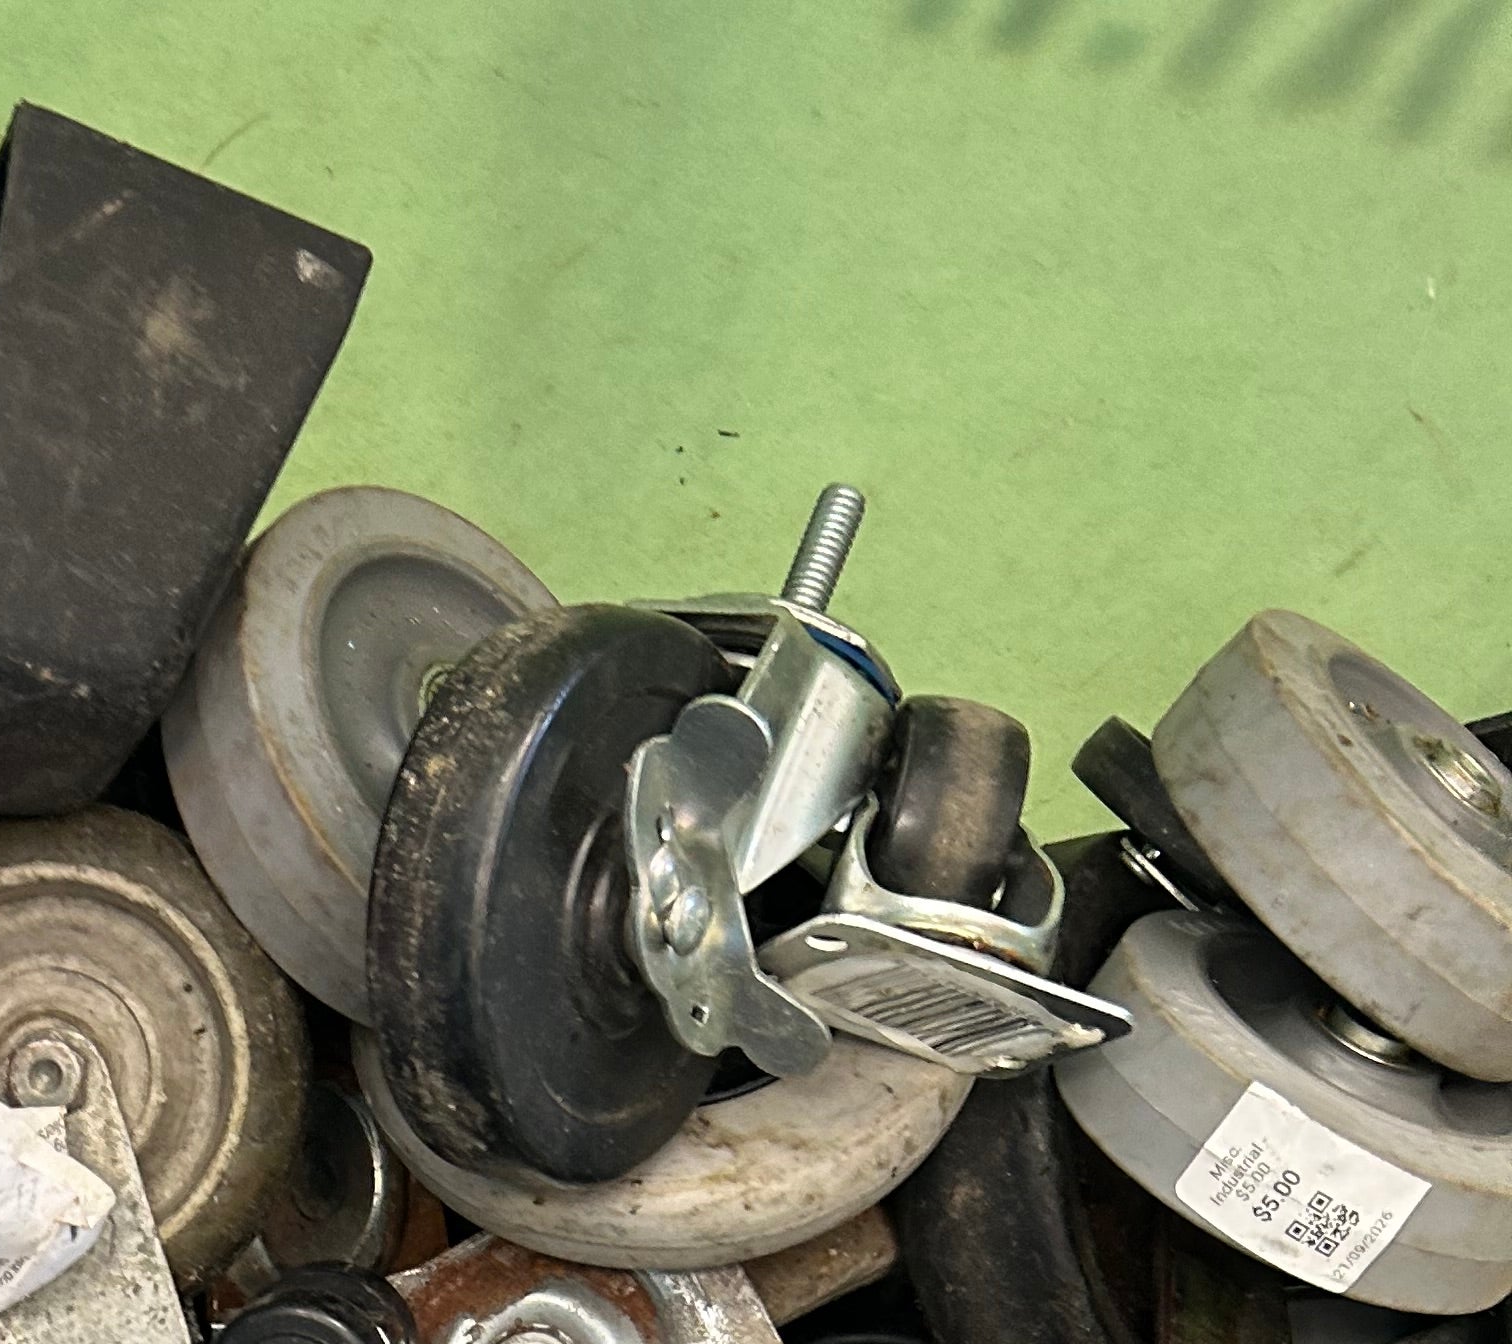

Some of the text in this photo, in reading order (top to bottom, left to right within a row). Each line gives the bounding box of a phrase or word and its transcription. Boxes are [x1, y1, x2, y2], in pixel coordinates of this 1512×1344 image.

[1208, 1146, 1243, 1181] Misc.
[1210, 1142, 1264, 1206] Industrial
[1235, 1162, 1271, 1202] $5.00
[1252, 1169, 1301, 1222] $5.00
